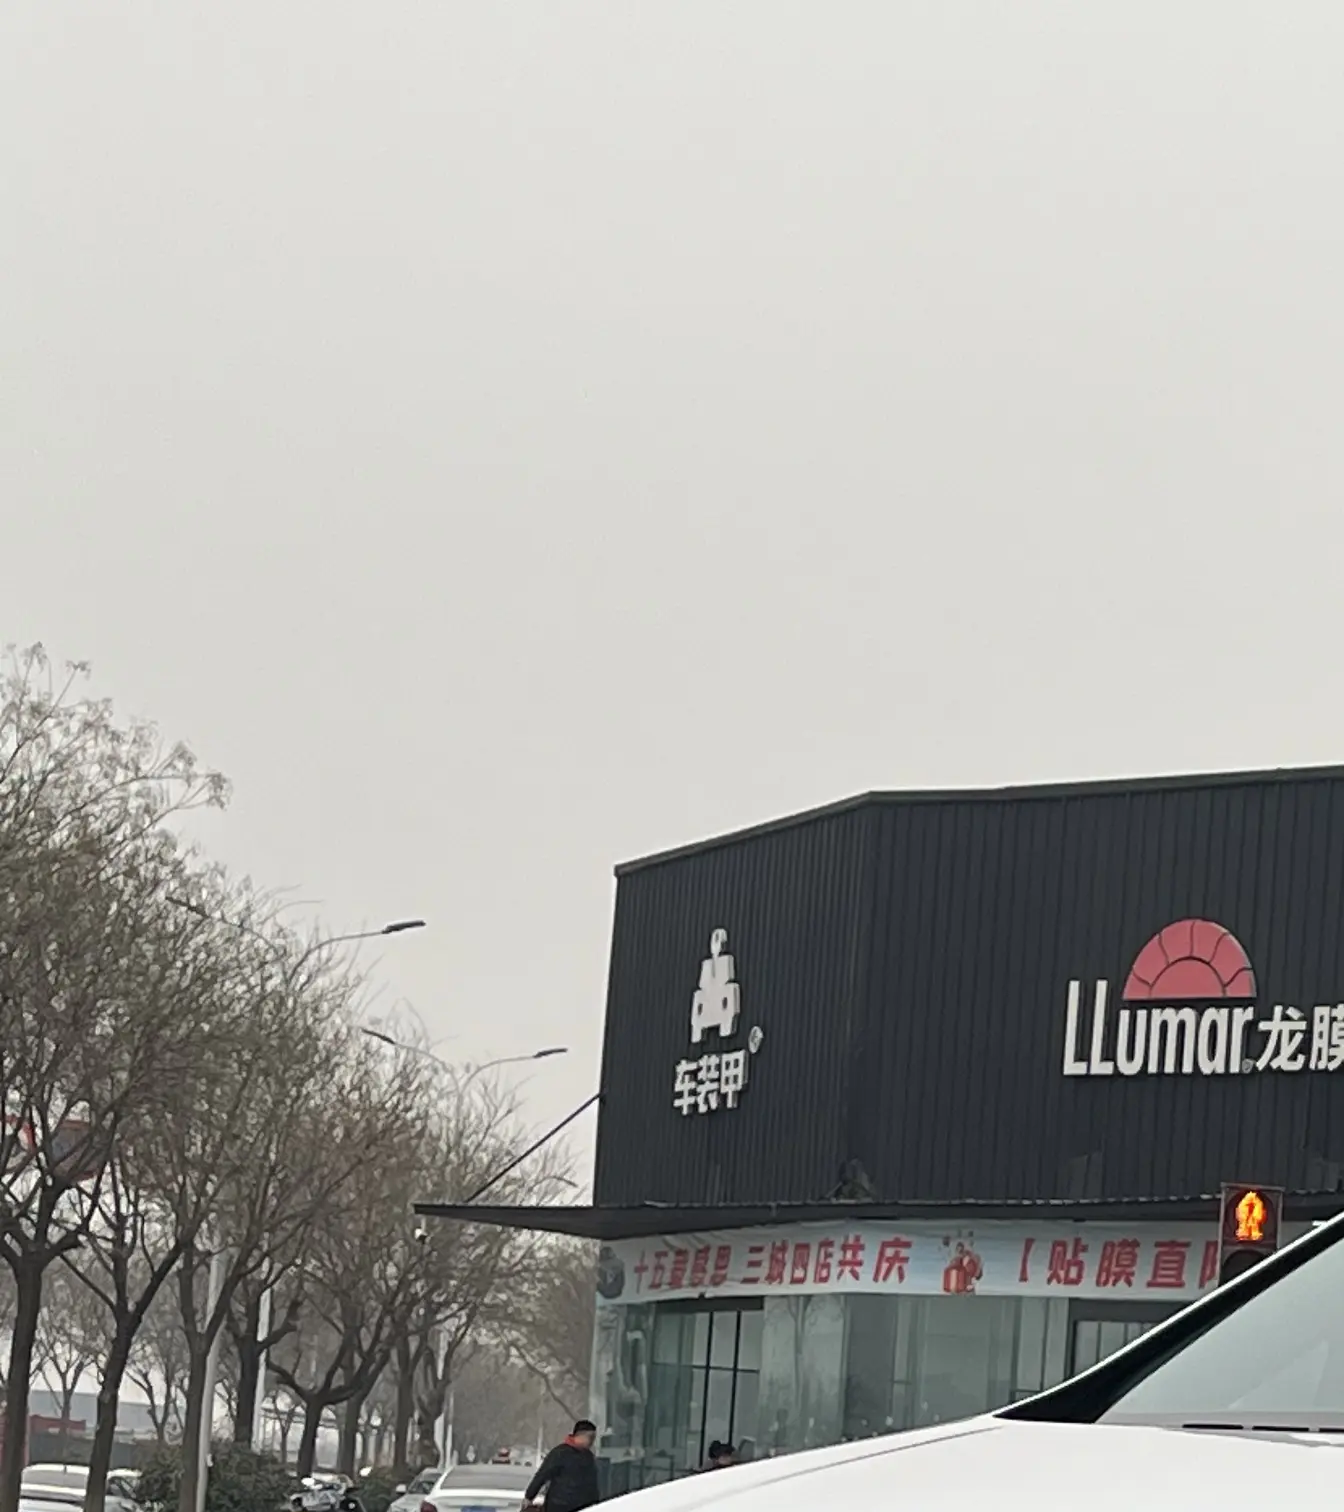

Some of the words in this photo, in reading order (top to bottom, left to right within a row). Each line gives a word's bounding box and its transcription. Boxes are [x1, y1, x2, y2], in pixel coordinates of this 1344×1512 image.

[1062, 979, 1254, 1076] LLumar
[673, 1049, 748, 1116] 车装甲
